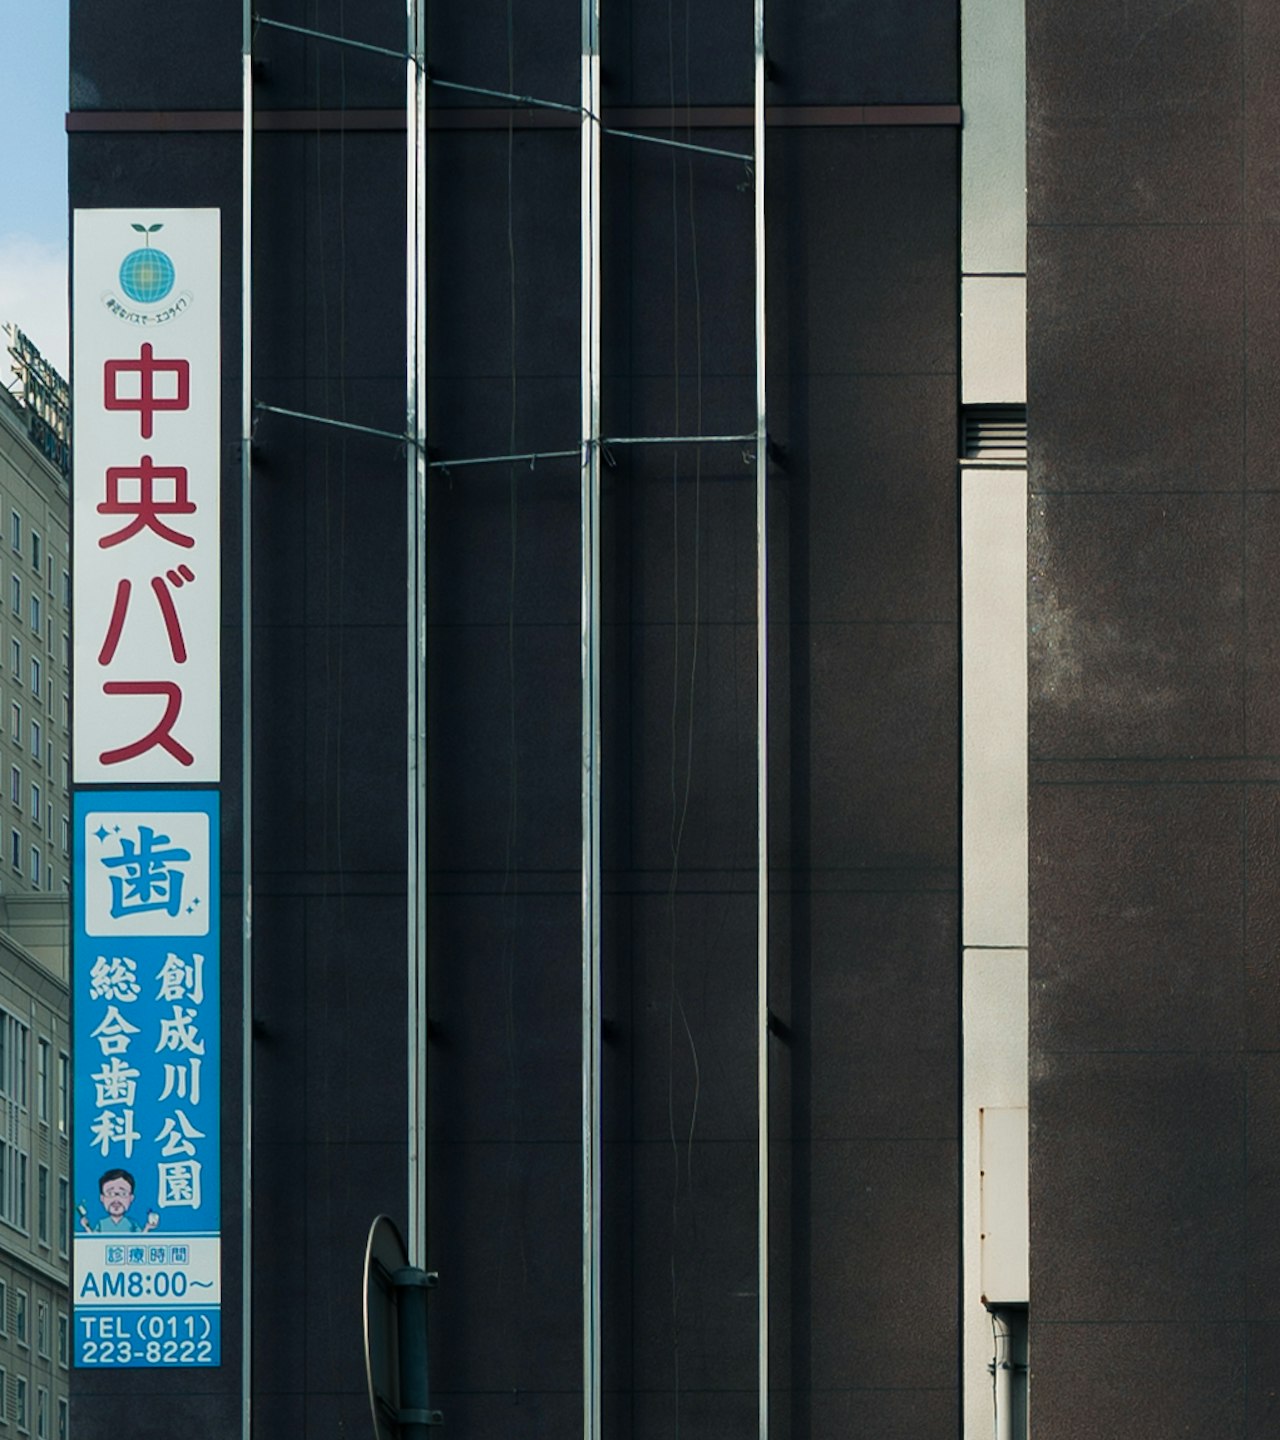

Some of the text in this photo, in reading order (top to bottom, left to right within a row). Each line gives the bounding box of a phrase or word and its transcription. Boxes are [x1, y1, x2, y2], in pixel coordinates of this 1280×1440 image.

[97, 342, 196, 766] 中央バス
[101, 825, 191, 919] 歯
[90, 956, 141, 1159] 総合歯科
[154, 952, 205, 1210] 創成川公園
[82, 1340, 213, 1364] 223-8222
